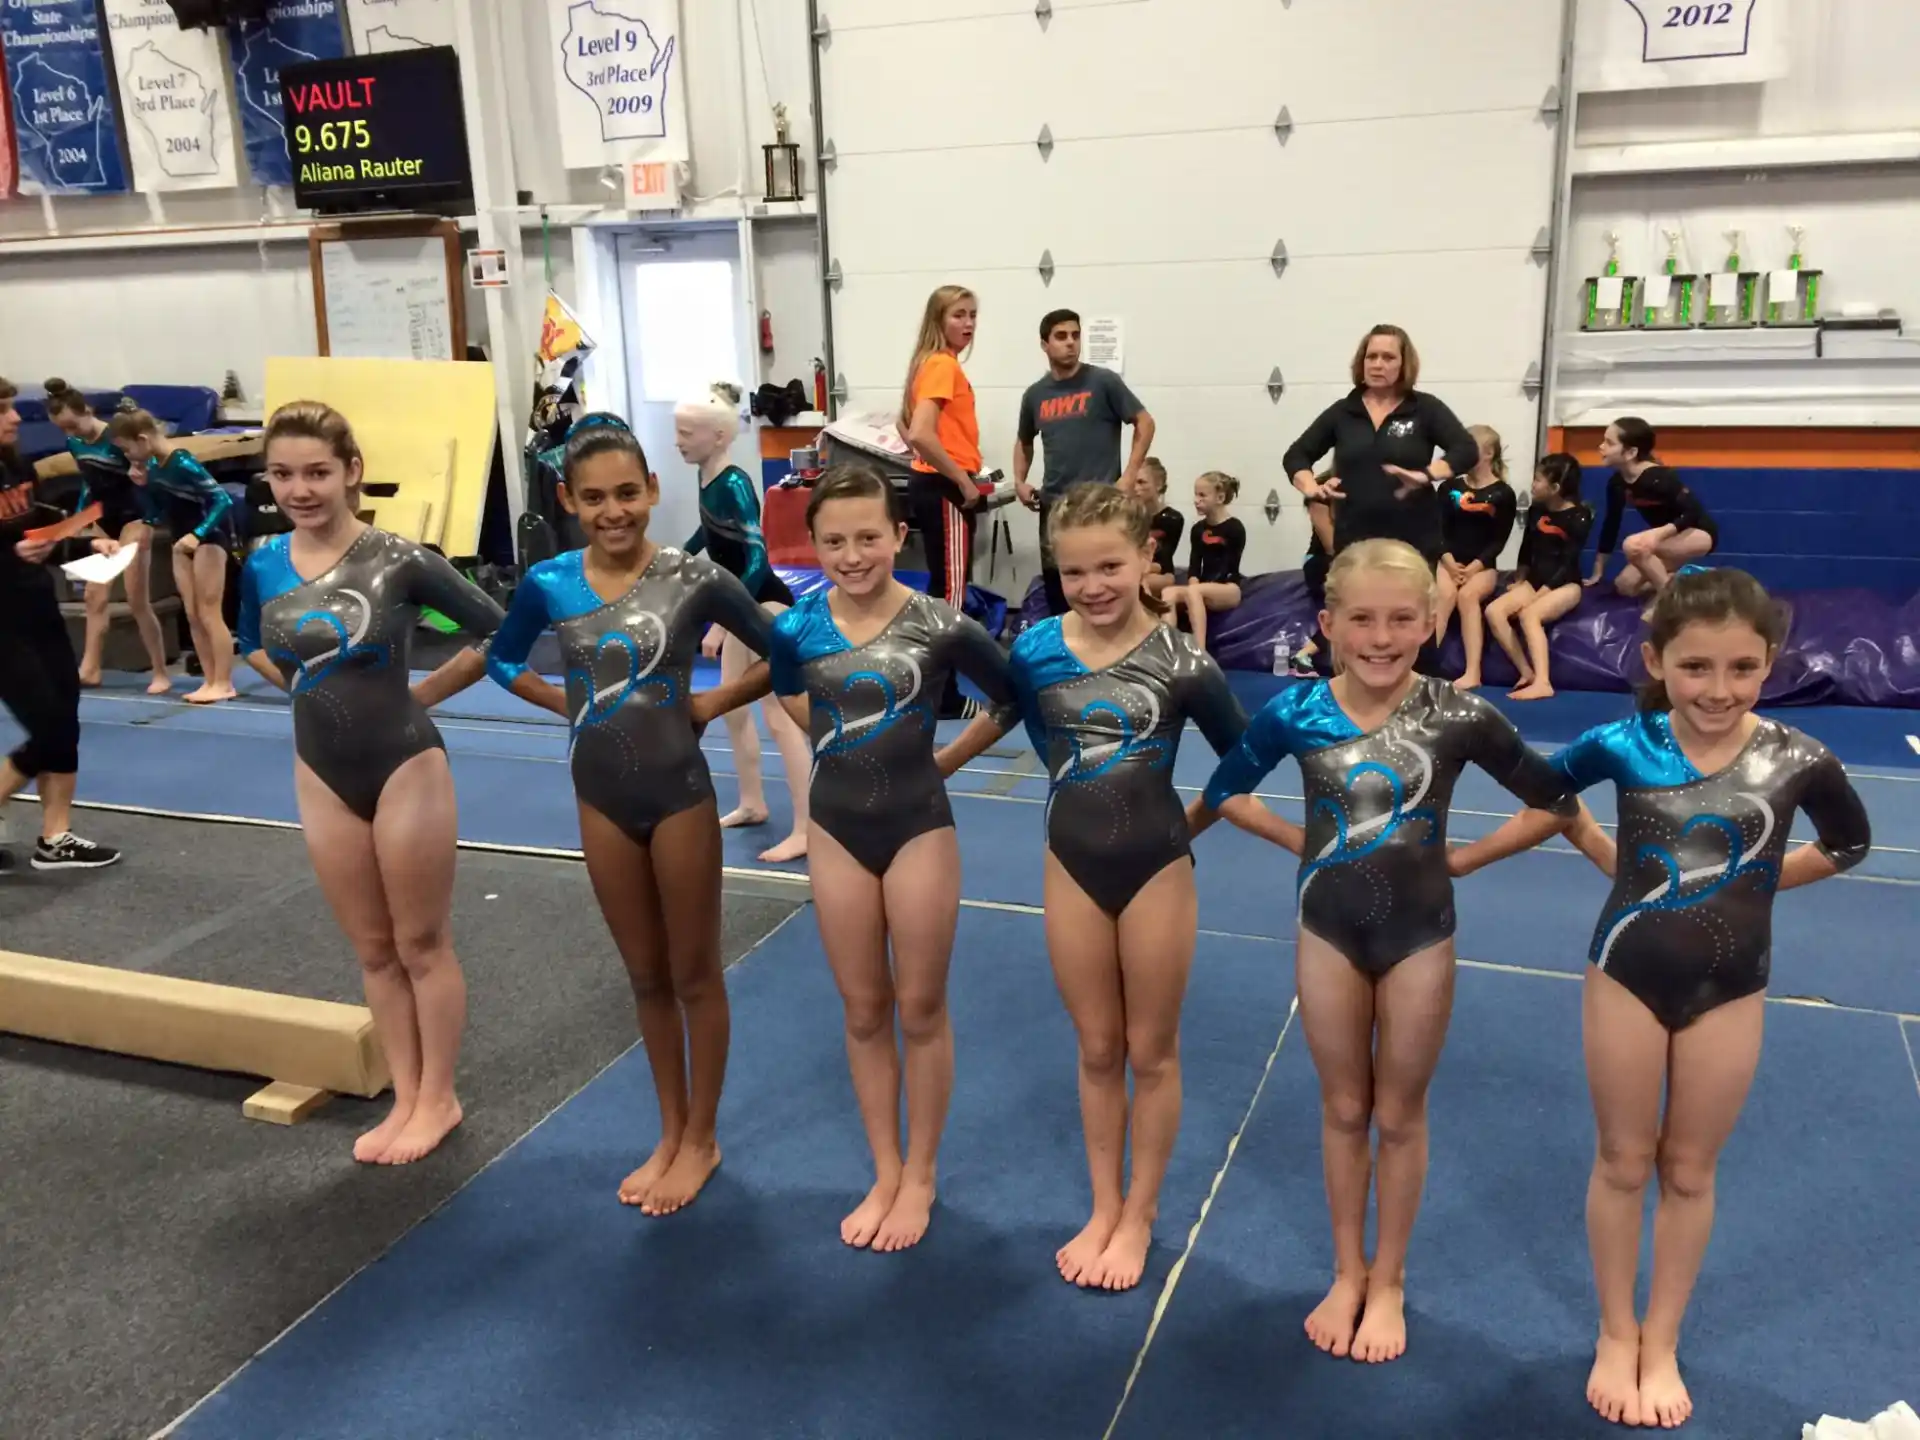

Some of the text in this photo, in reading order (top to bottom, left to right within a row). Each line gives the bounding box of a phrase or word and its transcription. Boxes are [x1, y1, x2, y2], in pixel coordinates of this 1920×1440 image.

[32, 10, 62, 25] State
[109, 10, 179, 30] Champion
[266, 0, 335, 24] pionships
[1663, 3, 1733, 28] 2012
[578, 29, 637, 57] Level 9
[138, 72, 186, 91] Level 7
[586, 64, 647, 87] 3rd Place
[33, 84, 77, 104] Level 6
[136, 94, 196, 111] 3rd Place
[289, 77, 376, 114] VAULT
[607, 94, 653, 116] 2009
[33, 106, 84, 124] 1st Place
[166, 136, 201, 154] 2004
[294, 119, 371, 153] 9.675
[58, 147, 87, 164] 2004
[300, 156, 424, 184] Aliana Rauter
[1039, 391, 1092, 420] MWT
